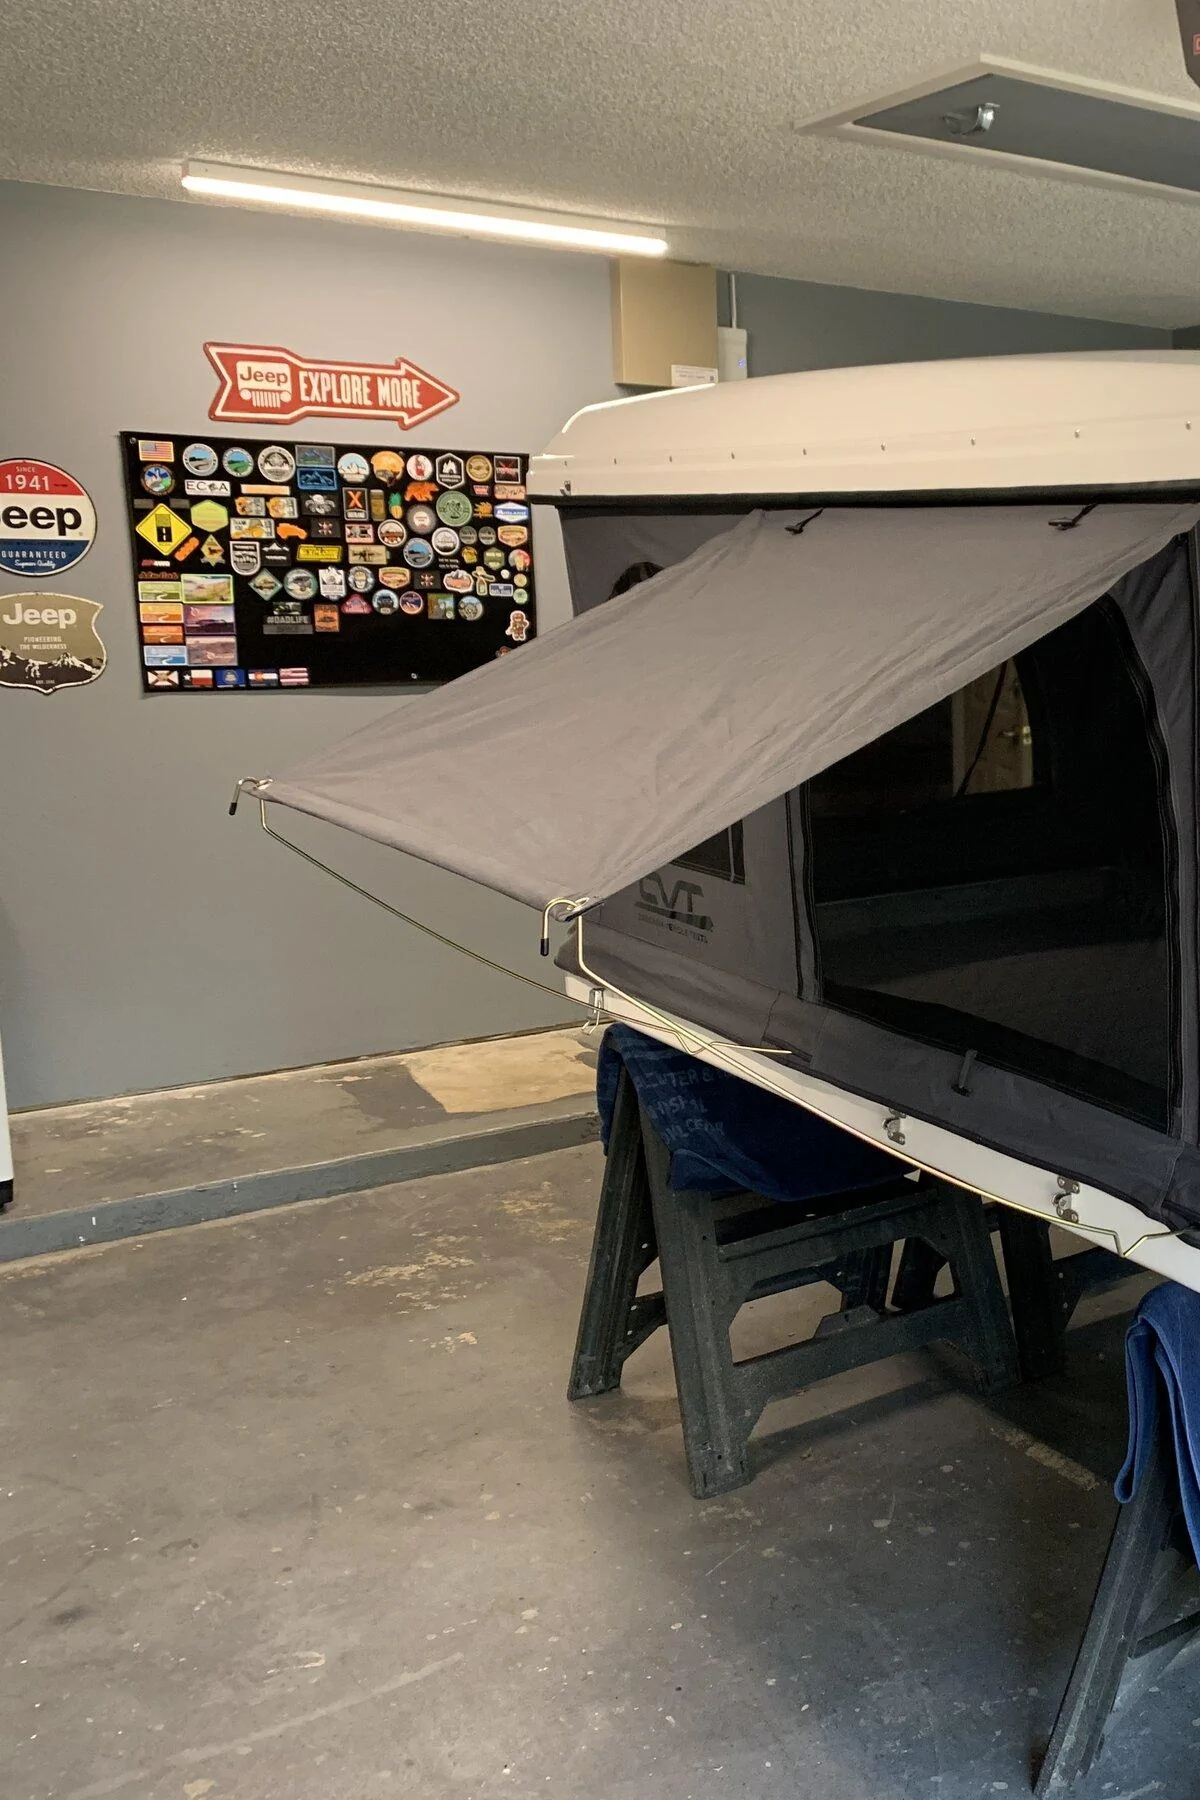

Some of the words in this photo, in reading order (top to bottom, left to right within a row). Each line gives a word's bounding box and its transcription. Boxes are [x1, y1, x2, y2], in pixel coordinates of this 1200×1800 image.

[239, 366, 288, 387] Jeep
[299, 370, 373, 406] EXPLORE
[377, 375, 423, 409] MORE
[5, 474, 50, 491] 1941
[0, 506, 82, 536] eep
[1, 550, 67, 559] GUARANTEED
[2, 603, 77, 629] Jeep
